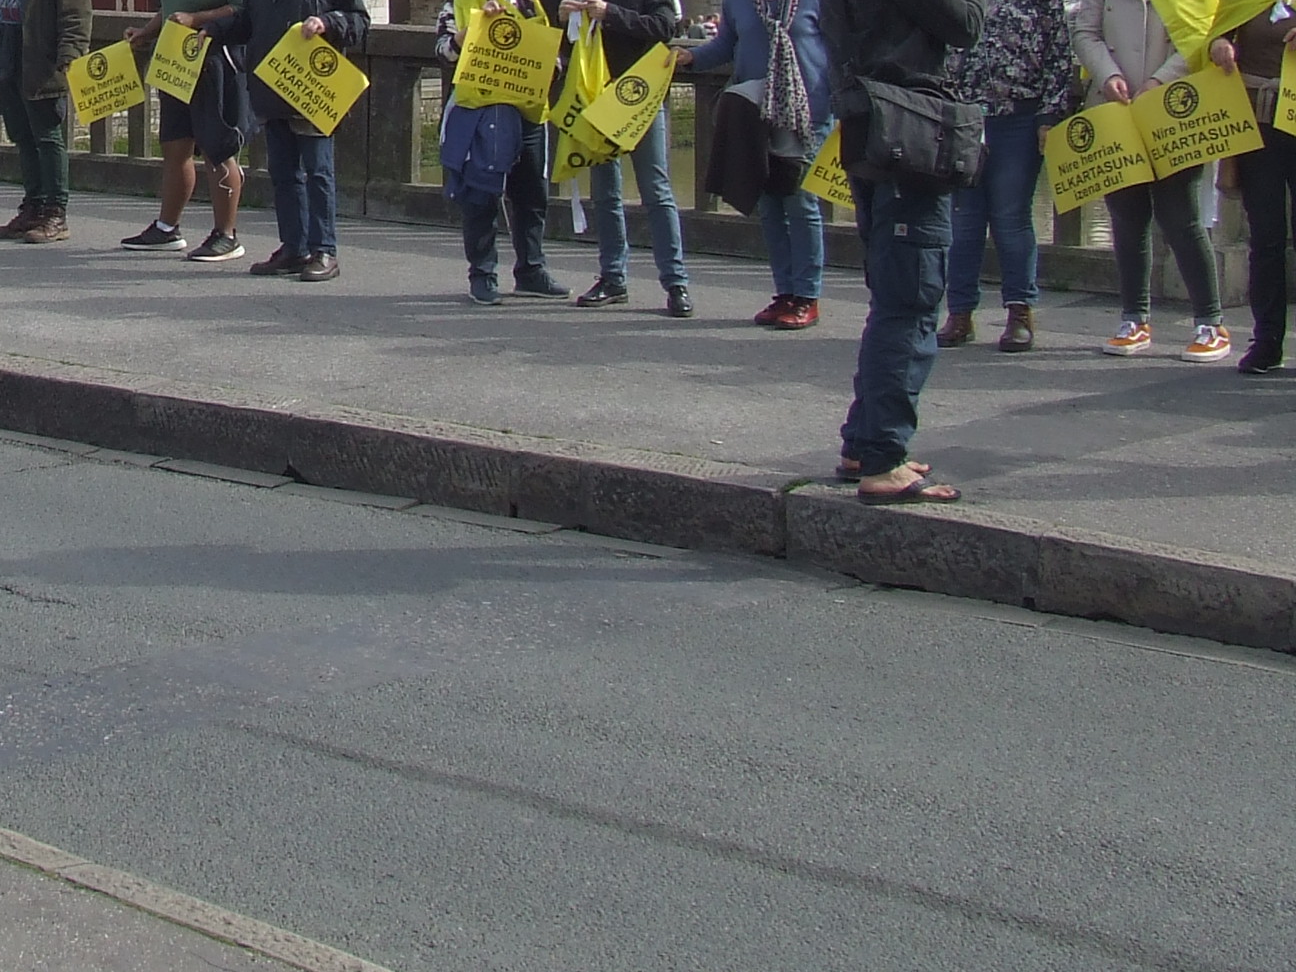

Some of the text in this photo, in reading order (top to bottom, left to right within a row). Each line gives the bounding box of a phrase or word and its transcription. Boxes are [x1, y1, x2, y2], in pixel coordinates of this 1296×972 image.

[155, 53, 170, 66] Mon
[467, 42, 542, 70] Construisons
[470, 57, 528, 80] des ponts
[81, 86, 96, 97] Nire
[268, 57, 338, 122] ELKARTASUNA
[284, 53, 337, 102] Nire herriak
[459, 72, 476, 82] pas
[479, 74, 500, 87] des
[504, 81, 535, 97] murs
[78, 80, 139, 111] ELKARTASUNA
[275, 78, 319, 118] izena du!
[613, 124, 628, 139] Mon
[1151, 109, 1230, 142] Nire herriak
[1151, 120, 1254, 160] ELKARTASUNA
[1058, 141, 1124, 176] Nire herriak
[1168, 139, 1231, 168] izena du!
[1054, 153, 1146, 195] ELKARTASUNA
[1073, 172, 1124, 201] izena du!
